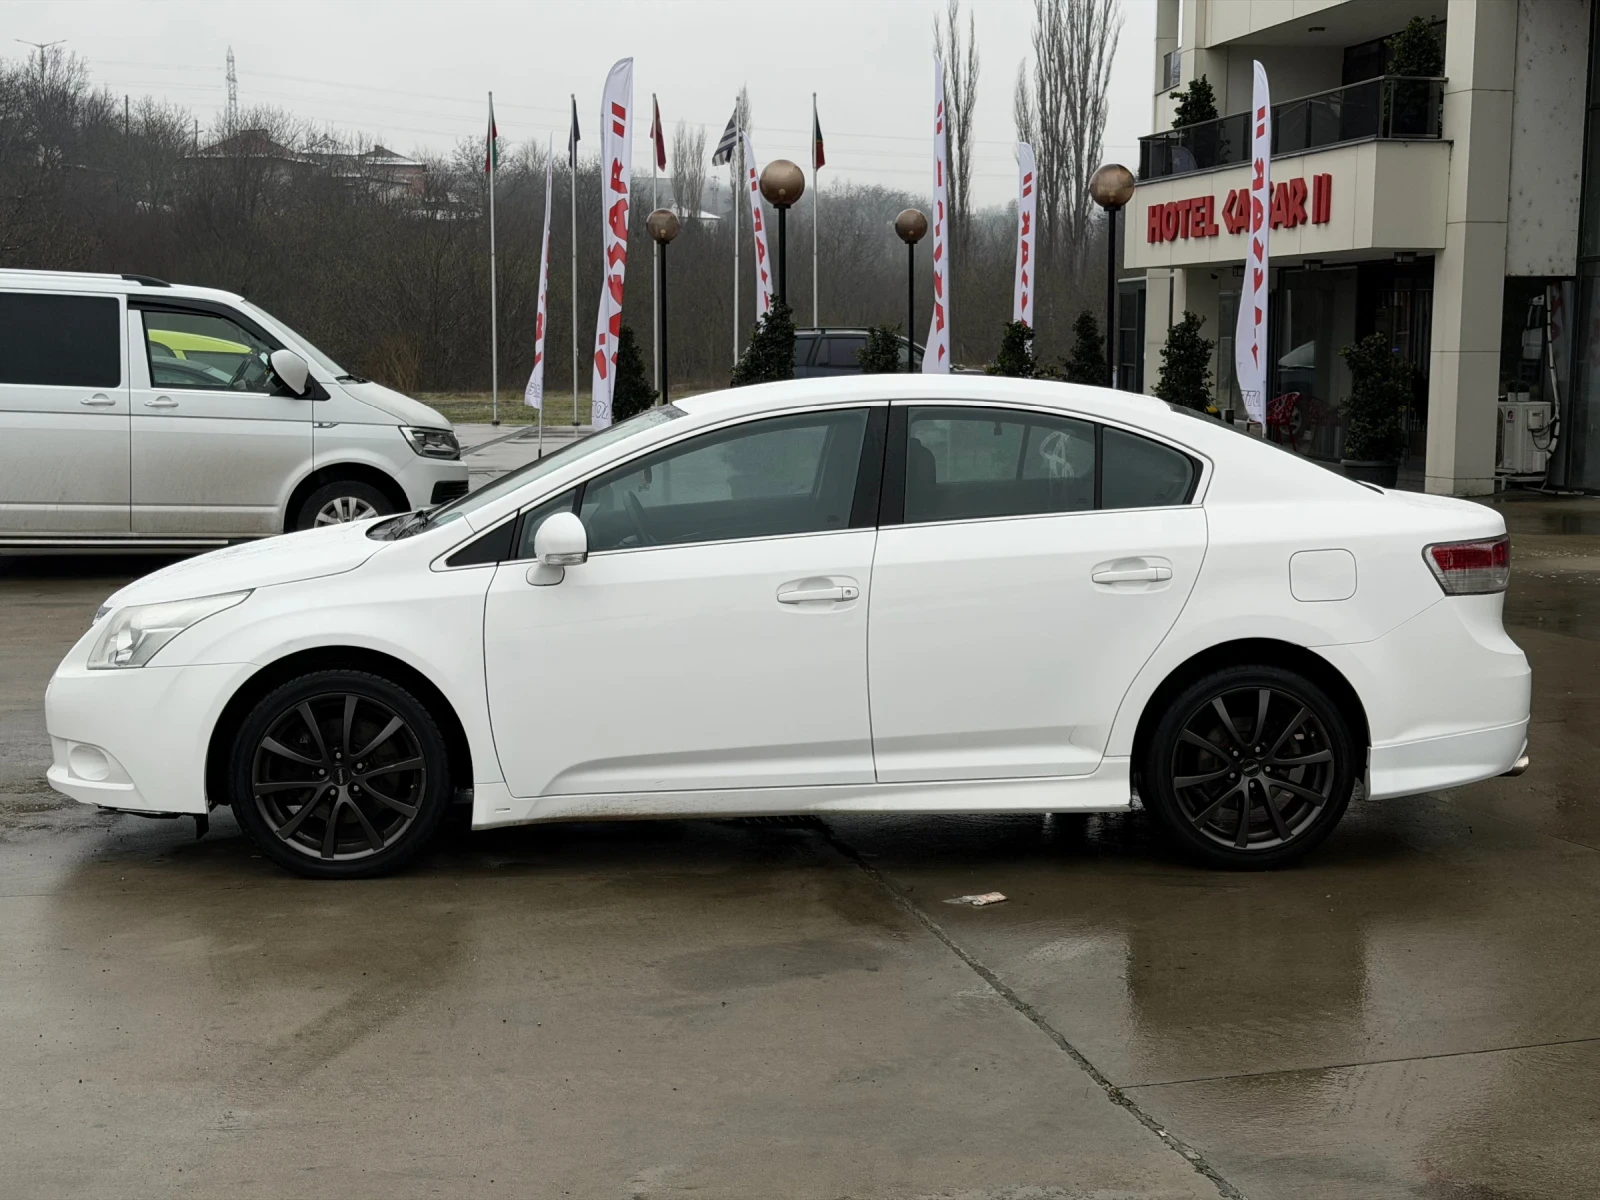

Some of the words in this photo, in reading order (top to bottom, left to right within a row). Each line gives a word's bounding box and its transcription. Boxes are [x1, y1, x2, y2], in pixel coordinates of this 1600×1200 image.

[1147, 195, 1219, 243] HOTEL
[1222, 177, 1308, 234] CAAR
[1312, 173, 1332, 224] II
